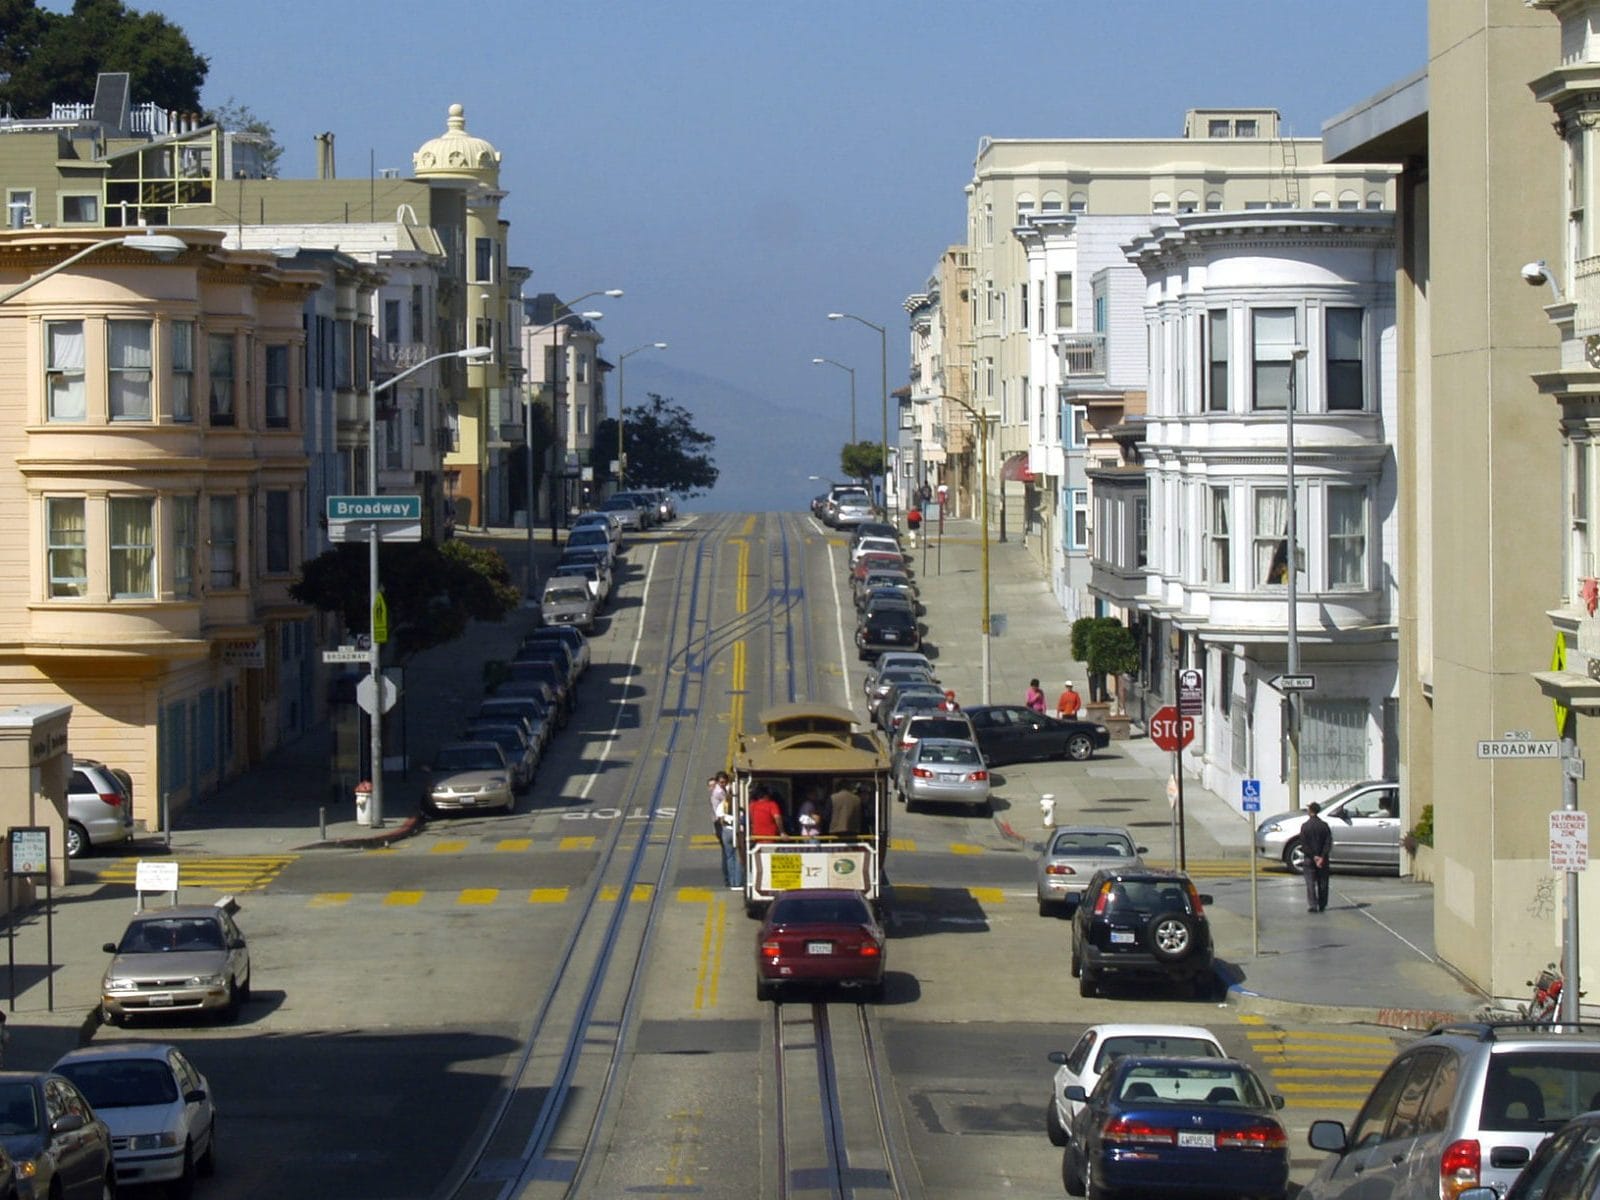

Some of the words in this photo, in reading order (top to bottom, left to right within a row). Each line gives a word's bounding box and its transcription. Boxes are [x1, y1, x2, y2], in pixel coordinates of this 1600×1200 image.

[337, 502, 410, 516] Broadway
[1296, 679, 1311, 687] WAY
[1152, 719, 1193, 739] STOP
[1482, 743, 1554, 756] BROADWAY
